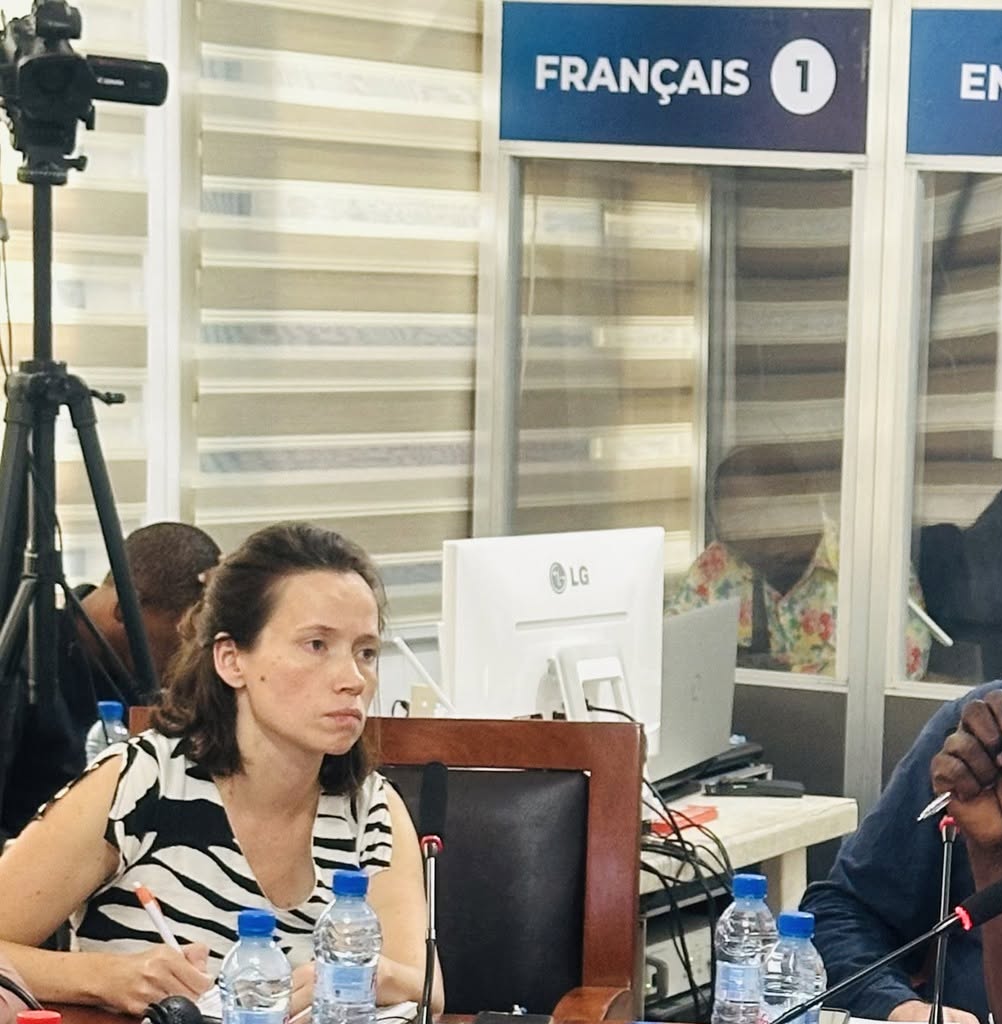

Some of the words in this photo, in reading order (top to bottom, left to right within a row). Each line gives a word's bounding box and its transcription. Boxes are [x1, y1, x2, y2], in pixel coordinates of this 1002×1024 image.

[535, 55, 750, 105] FRANÇAIS
[794, 60, 810, 92] 1
[570, 566, 589, 586] LG
